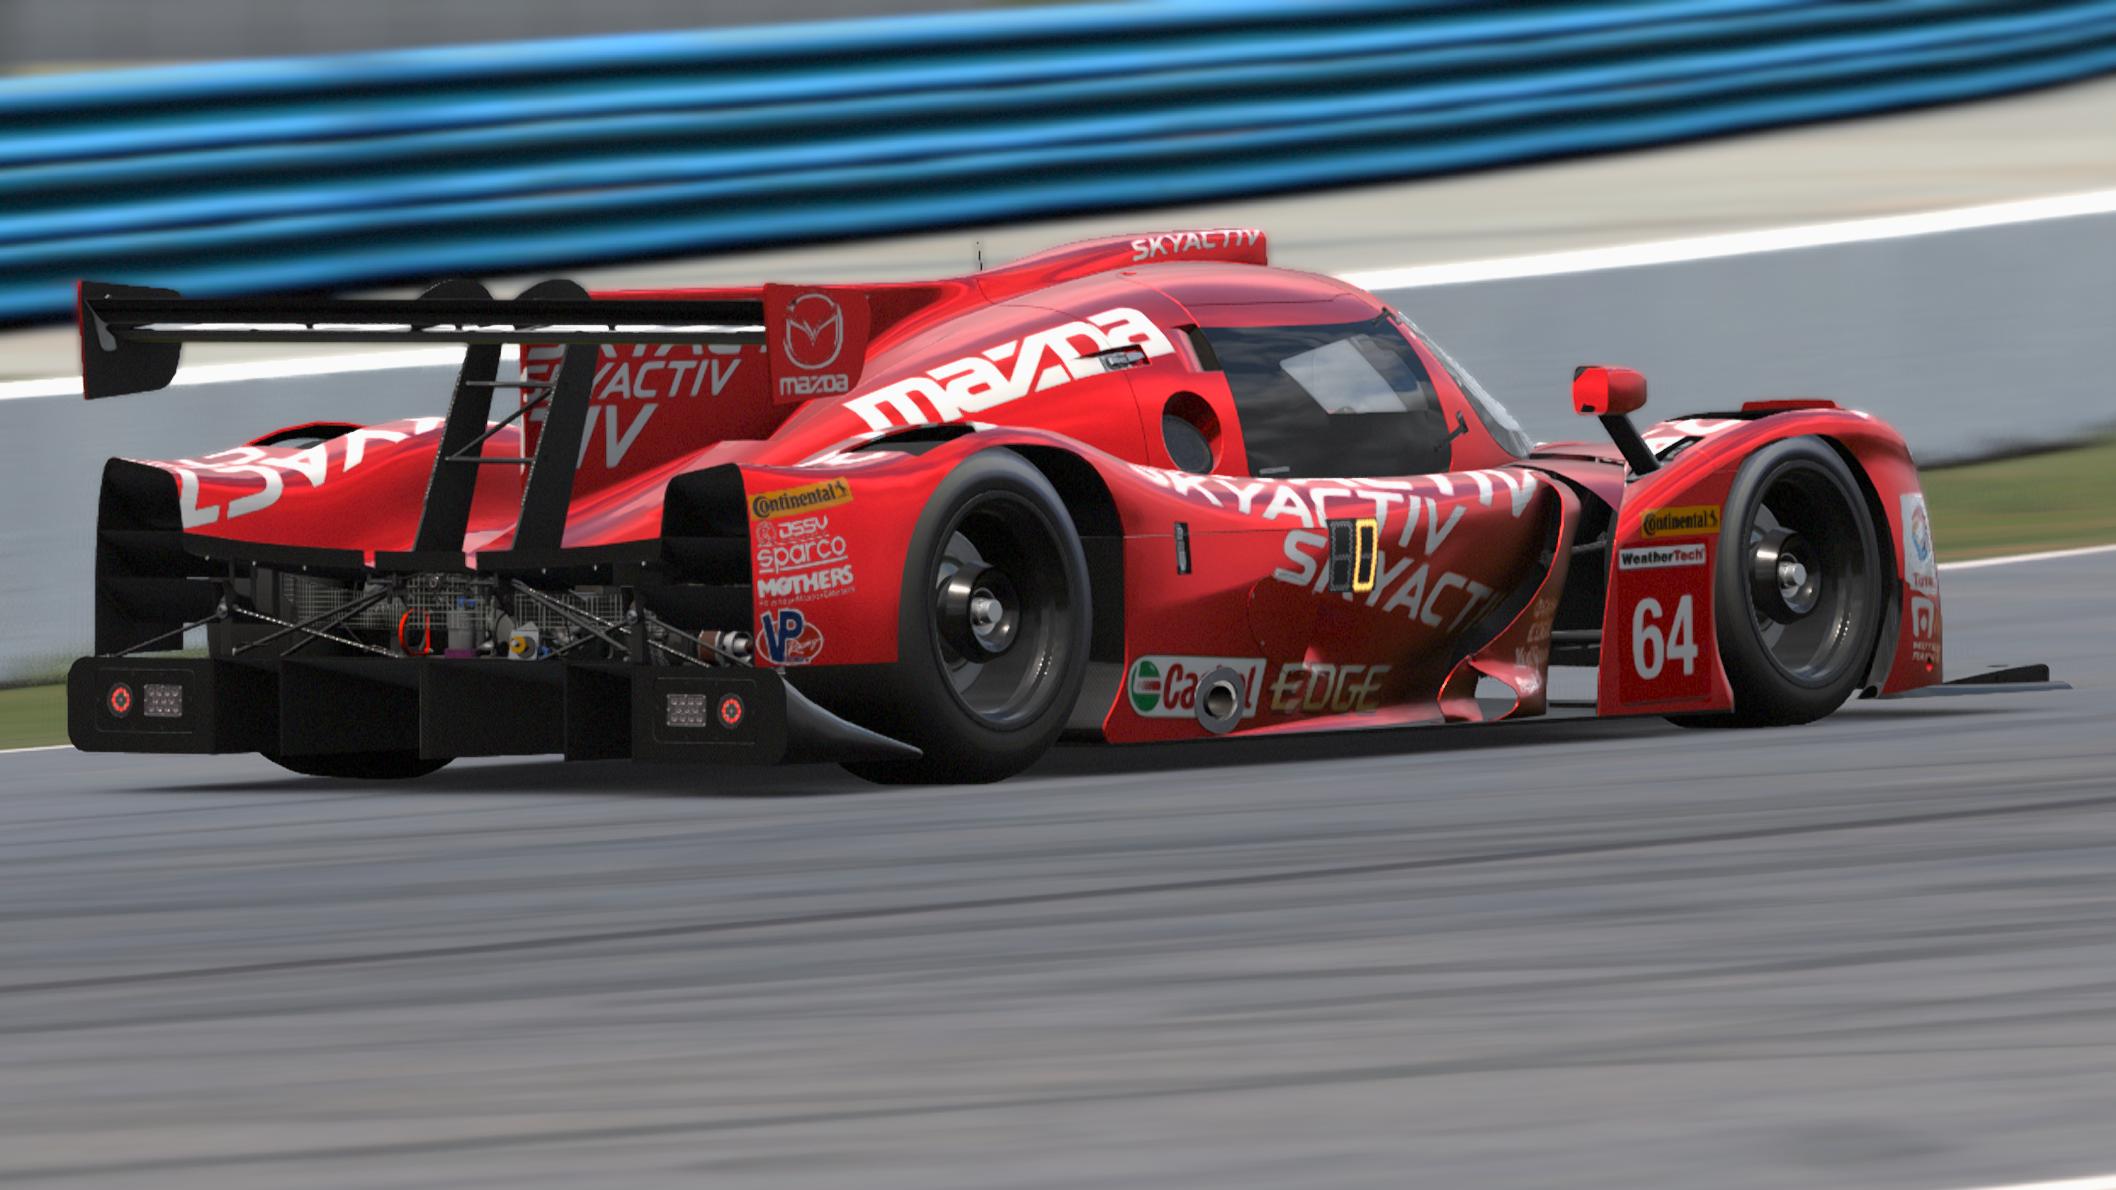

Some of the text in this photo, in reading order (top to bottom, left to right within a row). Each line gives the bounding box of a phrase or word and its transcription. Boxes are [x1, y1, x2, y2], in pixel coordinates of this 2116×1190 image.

[1131, 229, 1260, 262] SKYACTIV
[753, 483, 835, 519] Continental
[1643, 510, 1707, 536] Continental
[757, 536, 846, 574] sparco
[1621, 549, 1704, 566] WeatherTech
[757, 564, 854, 599] MOTHERS
[760, 608, 805, 663] VP
[1632, 594, 1699, 681] 64
[1270, 663, 1392, 713] EDGE
